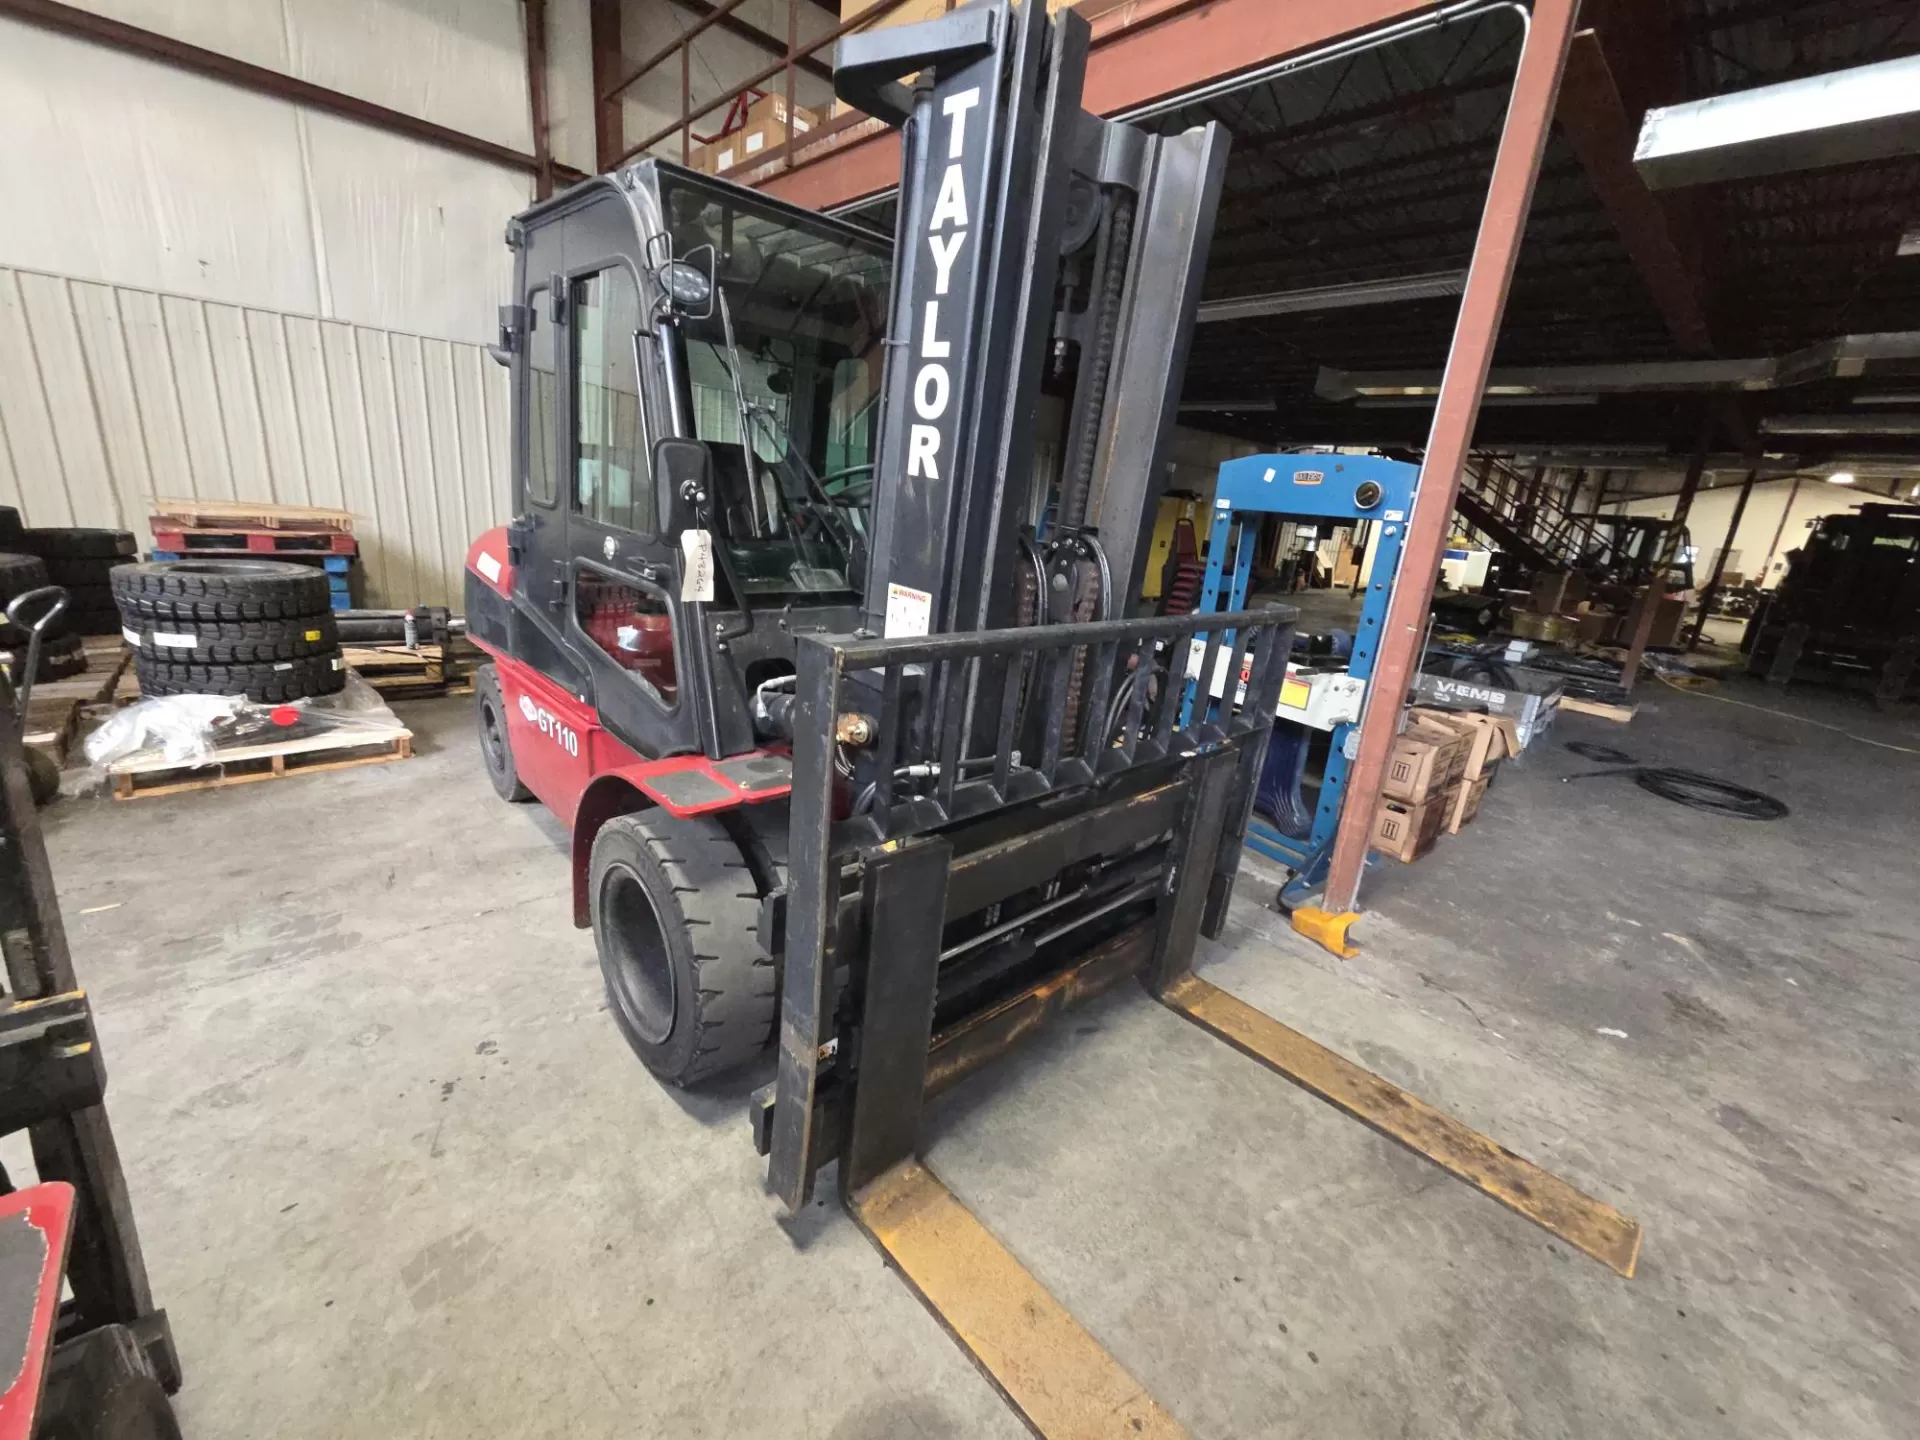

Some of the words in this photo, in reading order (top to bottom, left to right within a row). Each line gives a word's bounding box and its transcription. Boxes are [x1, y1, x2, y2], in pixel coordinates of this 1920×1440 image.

[907, 86, 980, 480] TAYLOR
[898, 589, 927, 603] WARNING
[537, 707, 578, 757] GT110
